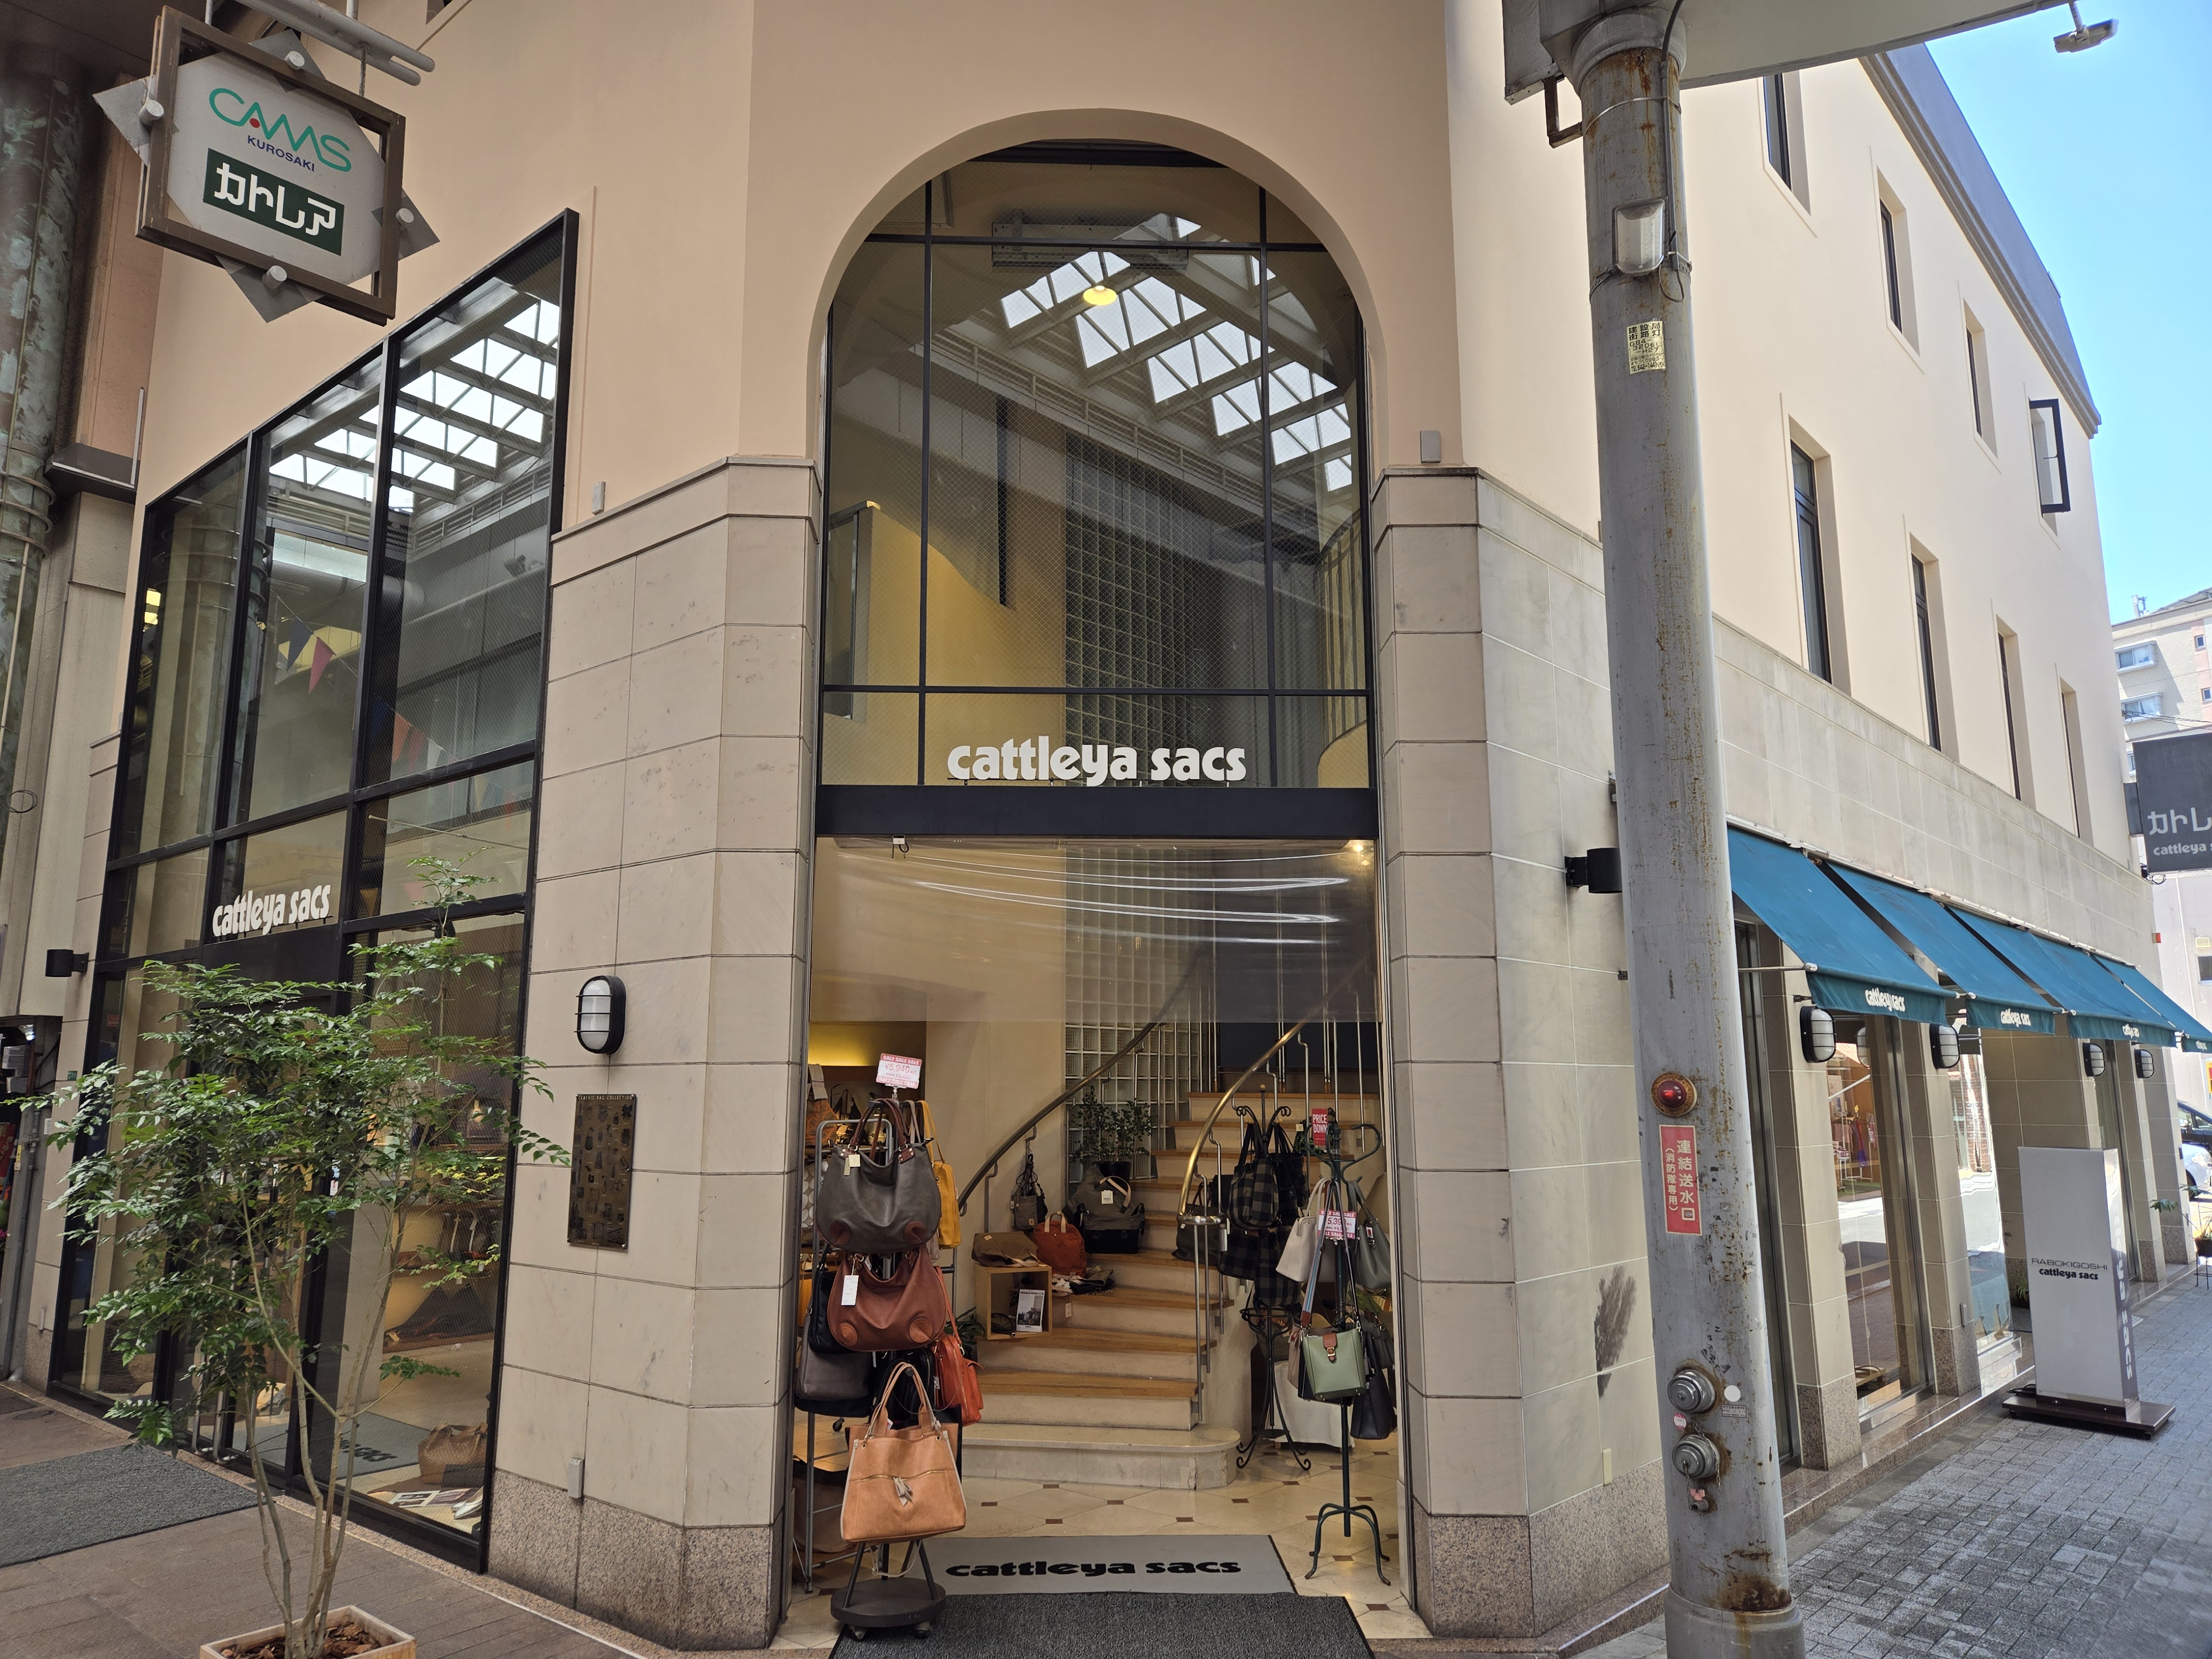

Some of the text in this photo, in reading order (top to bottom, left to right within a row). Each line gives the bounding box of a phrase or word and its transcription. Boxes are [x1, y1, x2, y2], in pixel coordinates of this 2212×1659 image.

[247, 135, 315, 172] KUROSAKI
[1629, 322, 1660, 334] 建設局
[1629, 330, 1661, 341] 街路灯
[947, 735, 1246, 786] cattleya sacs
[2153, 842, 2206, 856] cattleya
[212, 885, 331, 937] cattleya sacs
[885, 1063, 910, 1073] ¥5,940
[1312, 1114, 1327, 1124] PRICE
[1313, 1124, 1327, 1133] DOWN
[1665, 1147, 1678, 1211] (消防隊専用)
[1677, 1140, 1695, 1221] 連結送水口
[2031, 1258, 2108, 1270] RABOKIGOSHI
[2039, 1268, 2077, 1279] cattleya
[2122, 1310, 2132, 1379] sacs
[946, 1561, 1241, 1577] cattleya sacs
